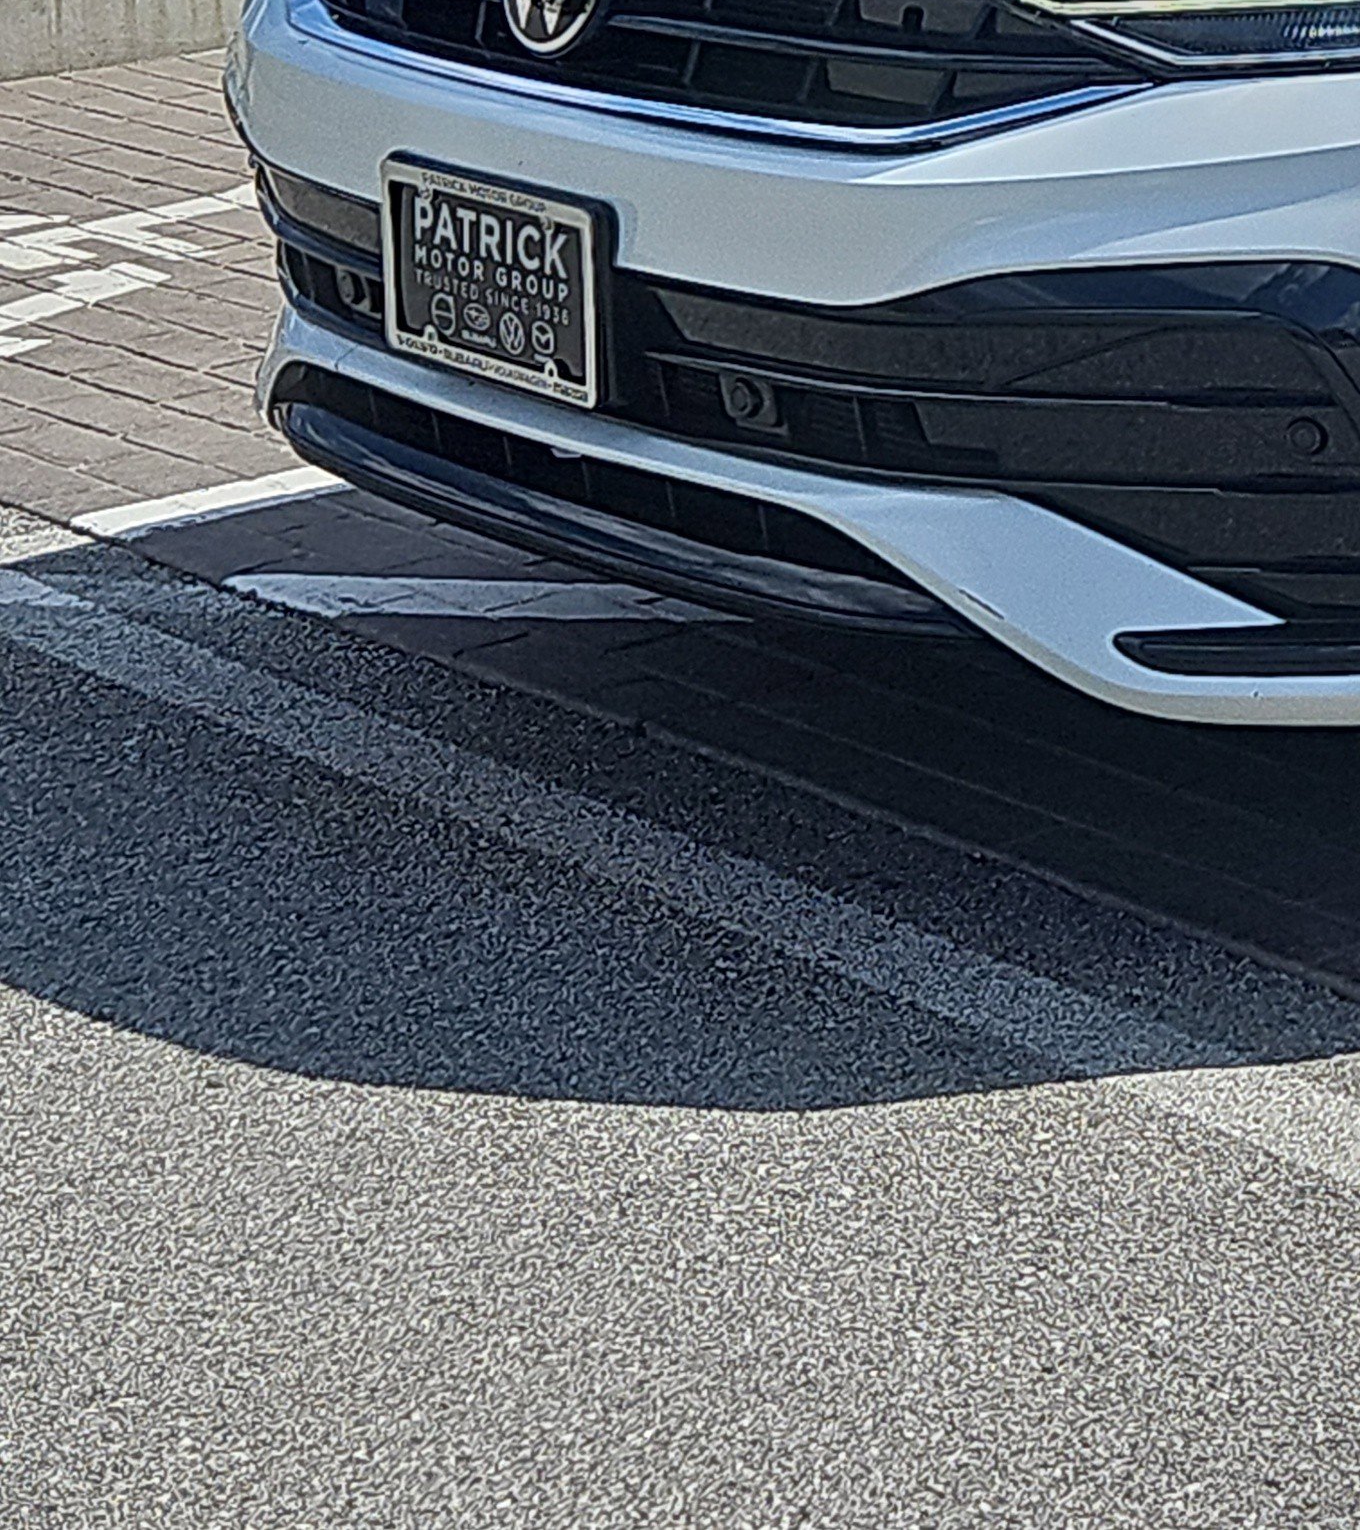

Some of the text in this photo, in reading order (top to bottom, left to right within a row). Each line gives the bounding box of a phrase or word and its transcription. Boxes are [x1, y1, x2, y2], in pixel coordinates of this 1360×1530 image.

[413, 194, 568, 280] PATRICK
[414, 243, 569, 303] MOTOR GROUP
[414, 267, 480, 301] TRUSTED
[486, 287, 530, 315] SINCE
